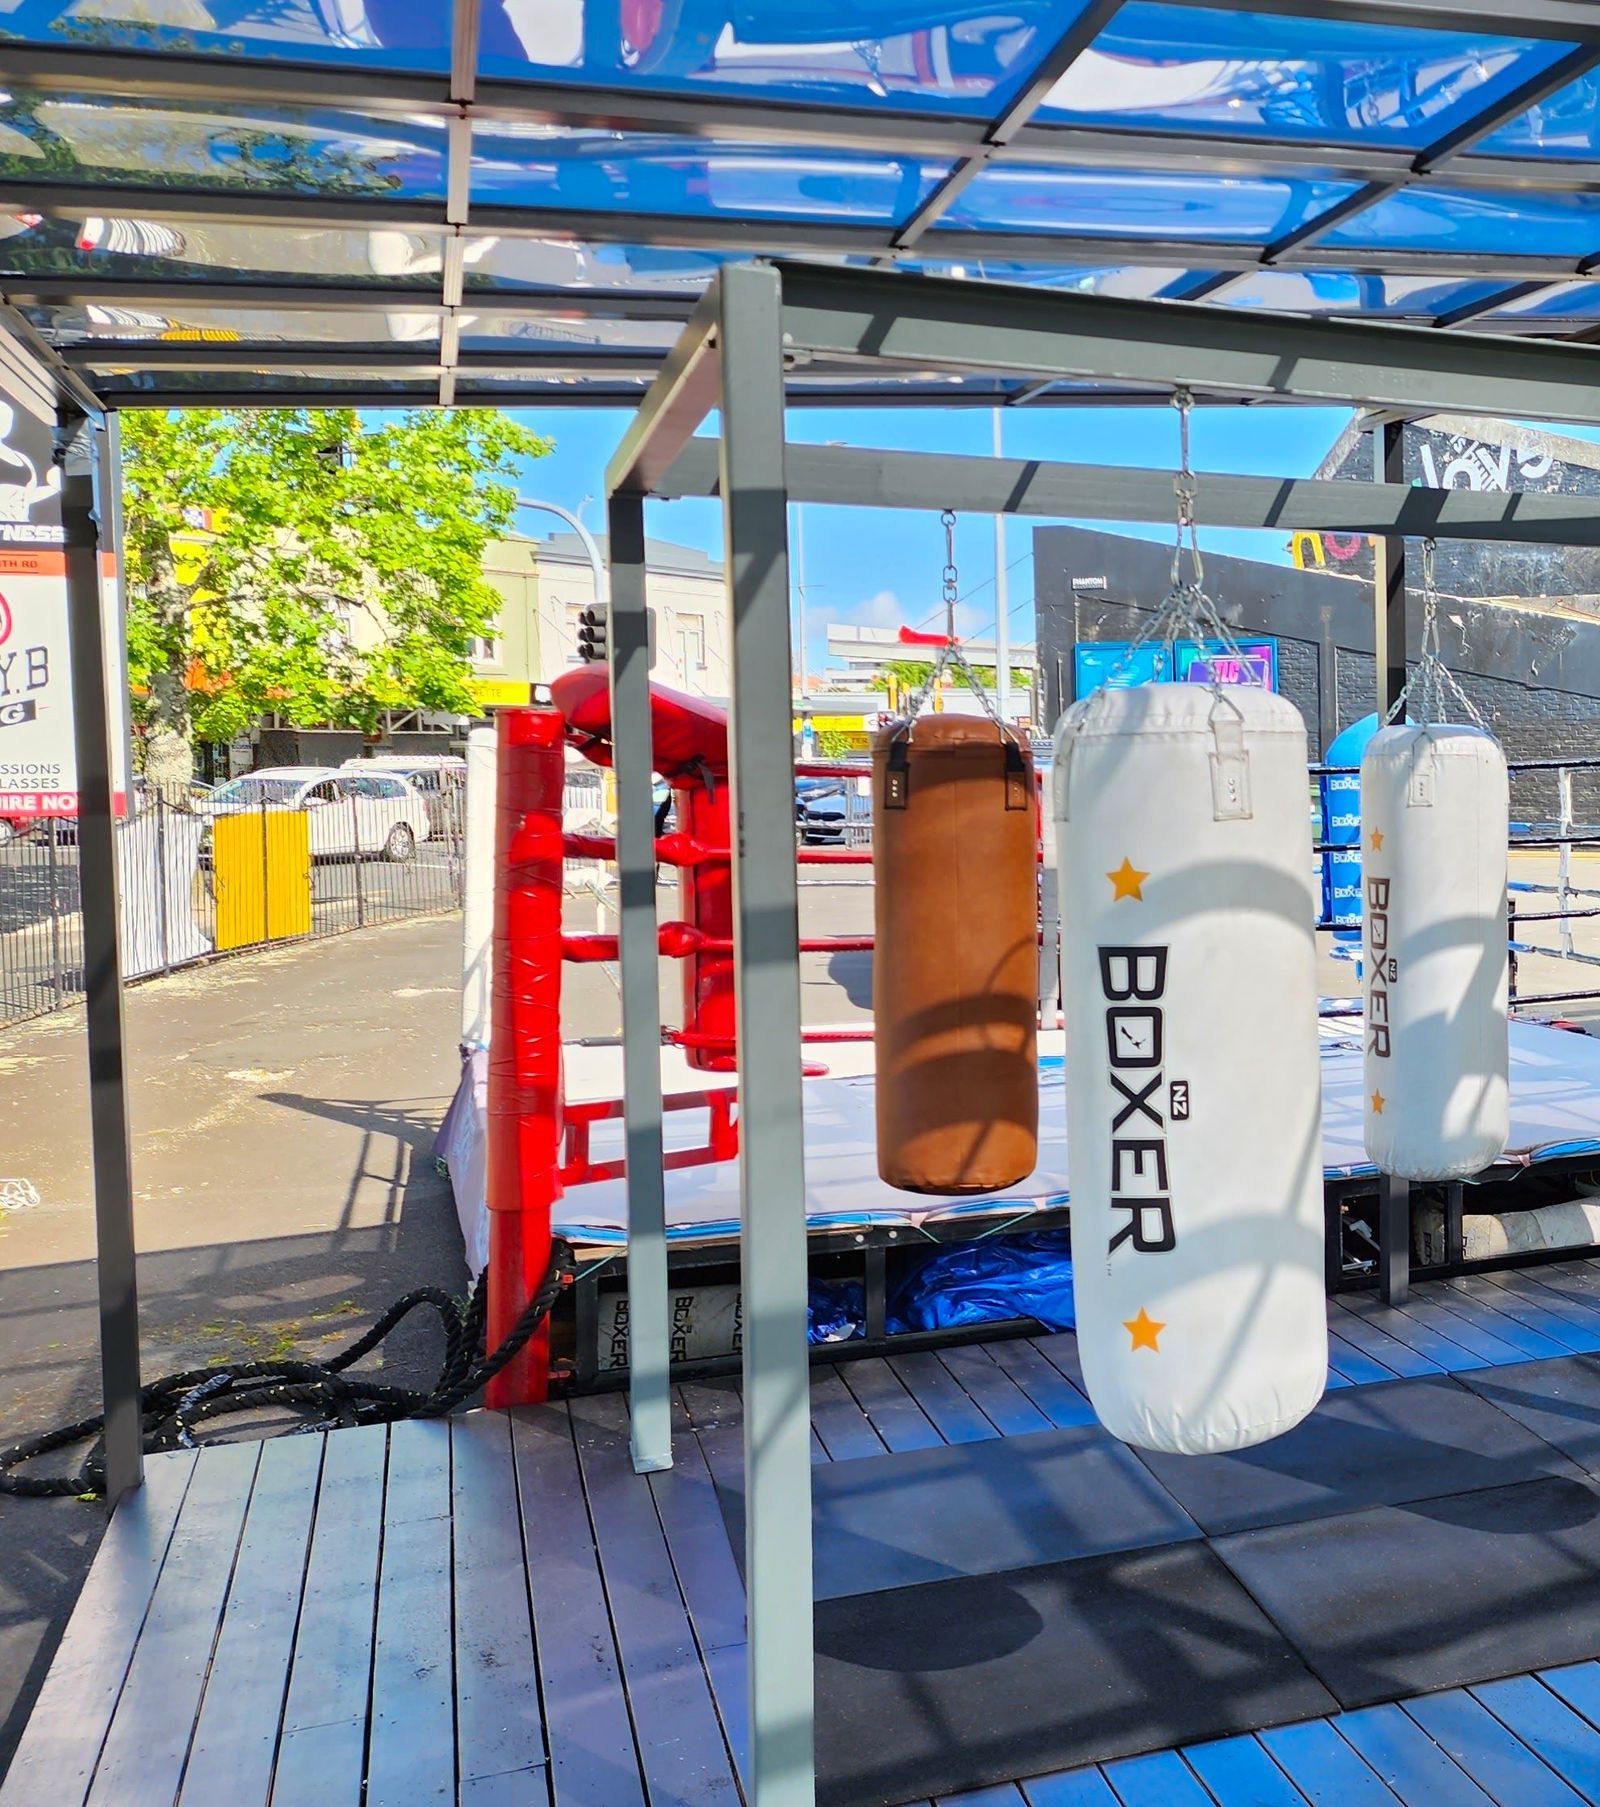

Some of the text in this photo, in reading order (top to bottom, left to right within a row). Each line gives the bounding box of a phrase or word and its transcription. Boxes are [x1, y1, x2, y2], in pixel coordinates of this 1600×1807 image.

[41, 794, 78, 811] NO
[1367, 877, 1391, 1059] BOXER
[1097, 944, 1178, 1257] BOXER
[1171, 1082, 1188, 1119] NZ
[670, 1296, 694, 1364] BOXER
